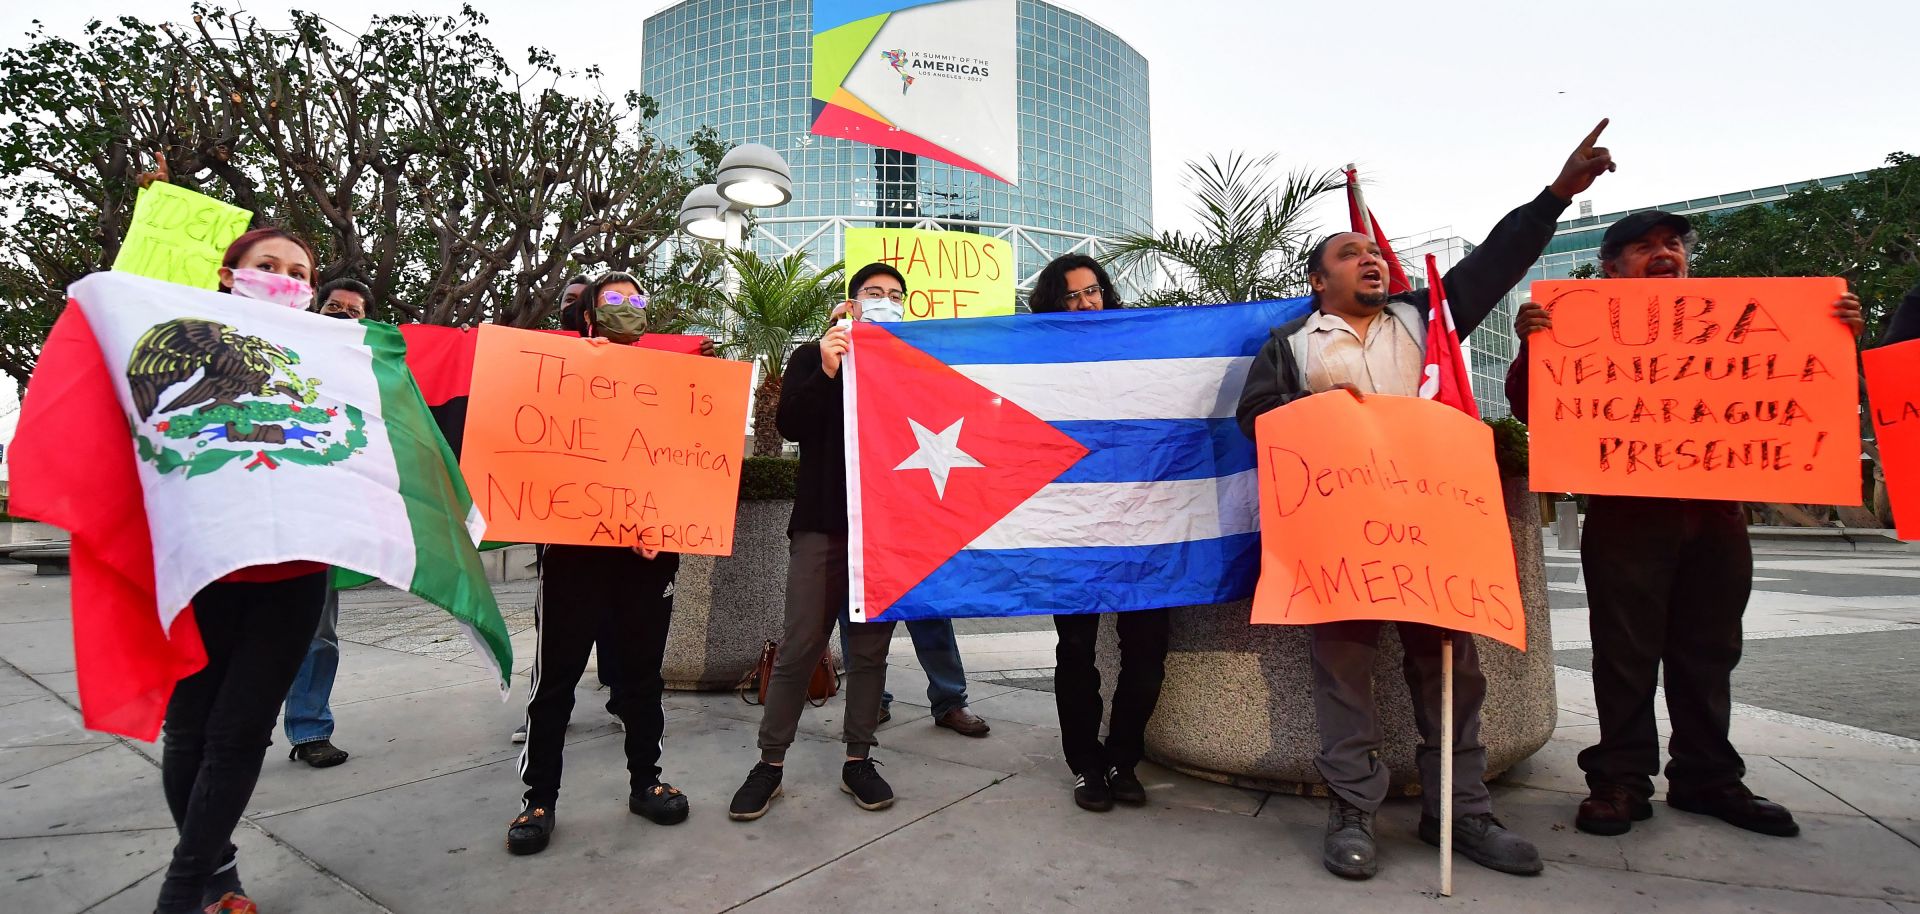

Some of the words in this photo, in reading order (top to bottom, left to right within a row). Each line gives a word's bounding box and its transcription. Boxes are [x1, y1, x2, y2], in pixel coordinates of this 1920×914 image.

[912, 59, 989, 77] AMERICAS
[923, 52, 956, 61] SUMMIT
[973, 58, 989, 66] THE
[933, 72, 962, 80] ANGELES
[878, 236, 1000, 281] HANDS
[909, 289, 980, 319] OFF
[1543, 286, 1791, 349] CUBA
[520, 350, 659, 407] There
[689, 383, 714, 416] is
[1542, 353, 1836, 387] VENEZUELA
[1554, 396, 1813, 426] NICARAGUA
[514, 404, 600, 452] ONE
[621, 428, 731, 478] America
[1598, 430, 1829, 475] PRESENTE!
[487, 472, 660, 523] NUESTRA
[590, 521, 725, 549] AMERICA!
[1363, 519, 1428, 547] OUR
[1284, 557, 1515, 631] AMERICAS
